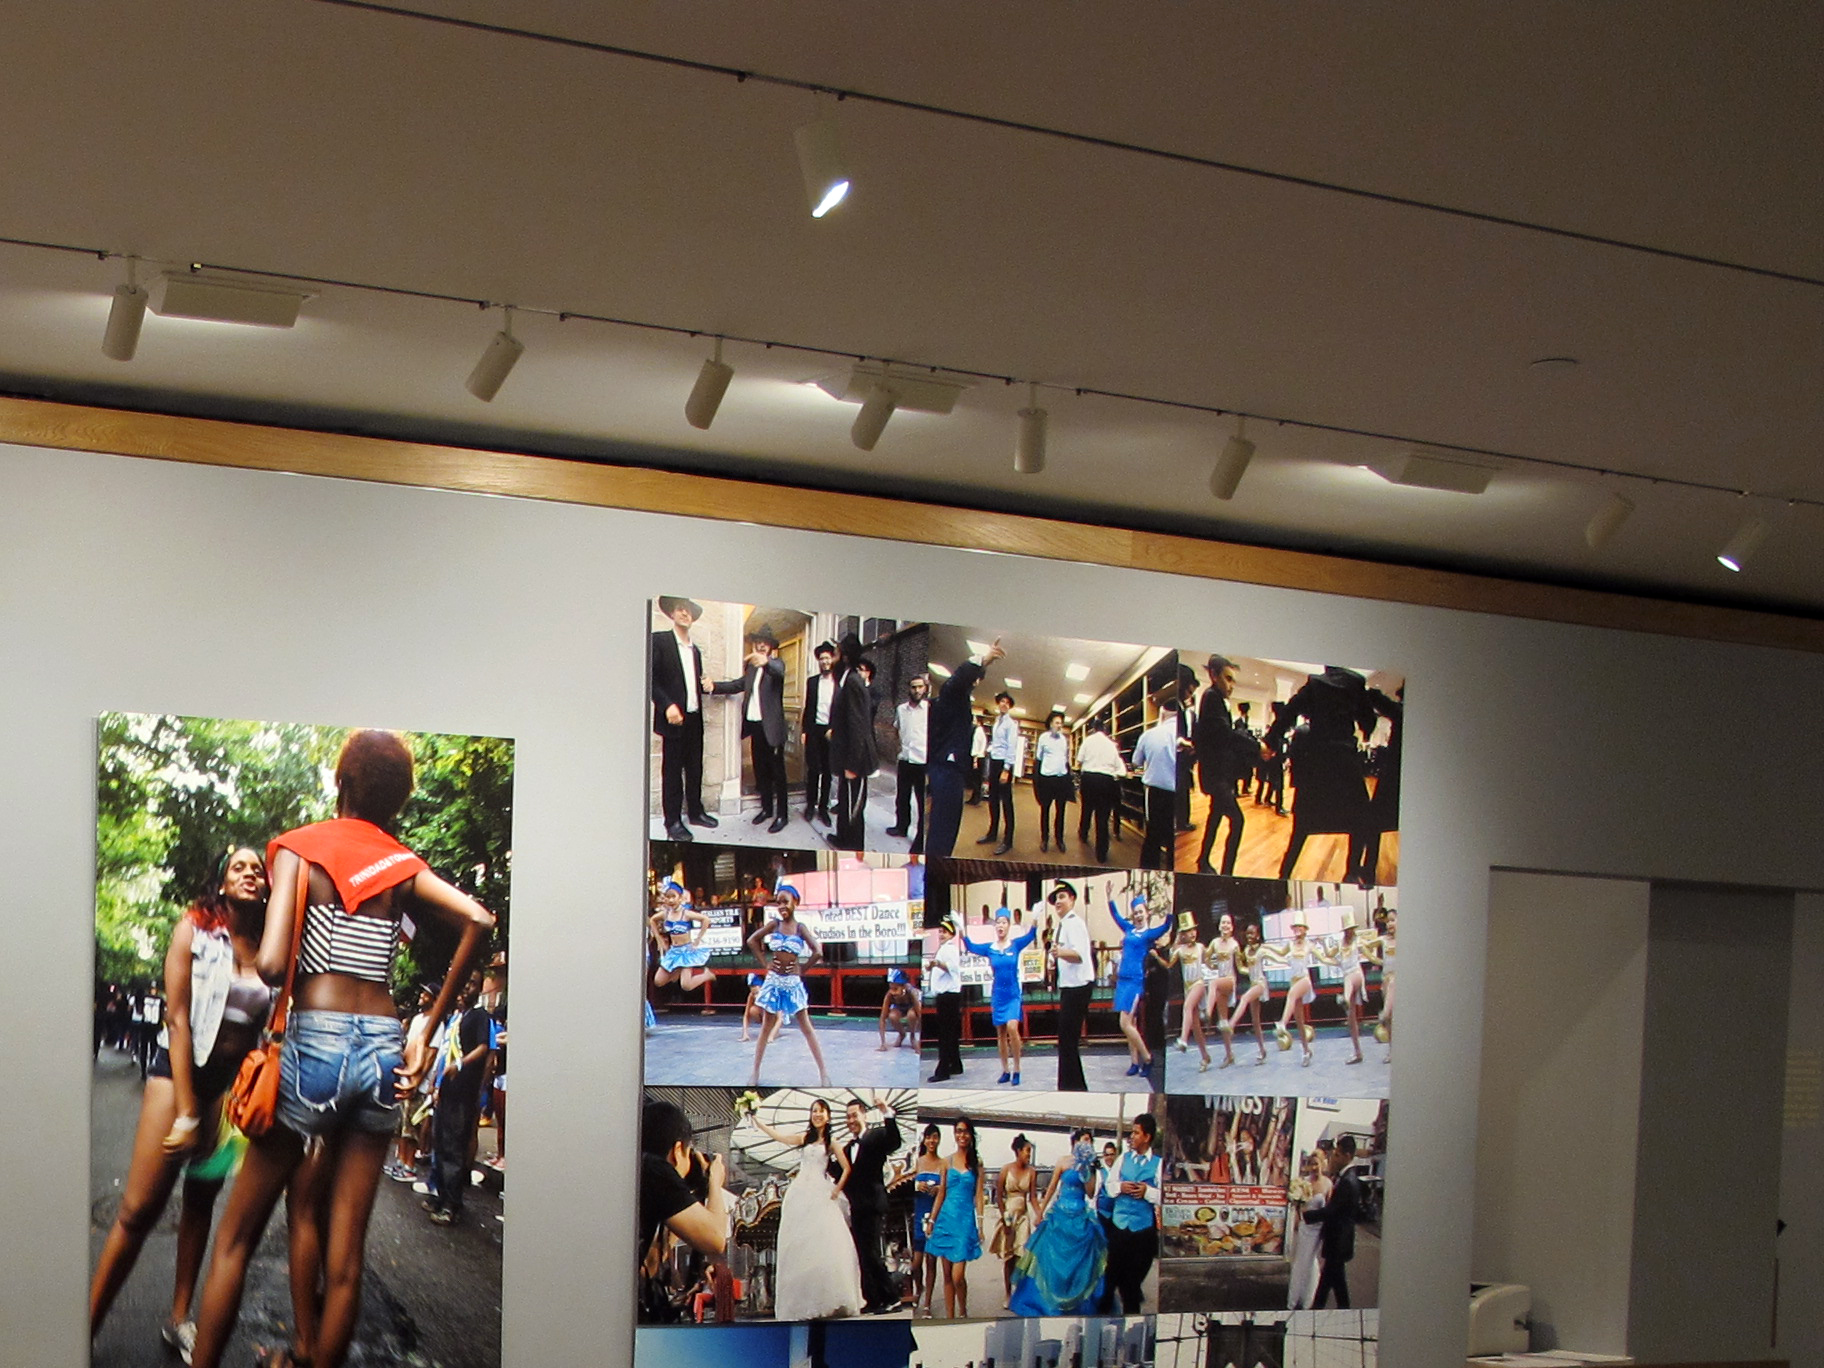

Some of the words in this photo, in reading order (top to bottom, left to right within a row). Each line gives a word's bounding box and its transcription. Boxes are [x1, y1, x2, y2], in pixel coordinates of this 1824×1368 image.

[817, 909, 843, 922] Voted
[845, 906, 869, 922] BEST
[871, 905, 900, 920] Dance
[813, 926, 846, 940] Studios
[847, 925, 856, 938] In
[858, 925, 873, 937] the
